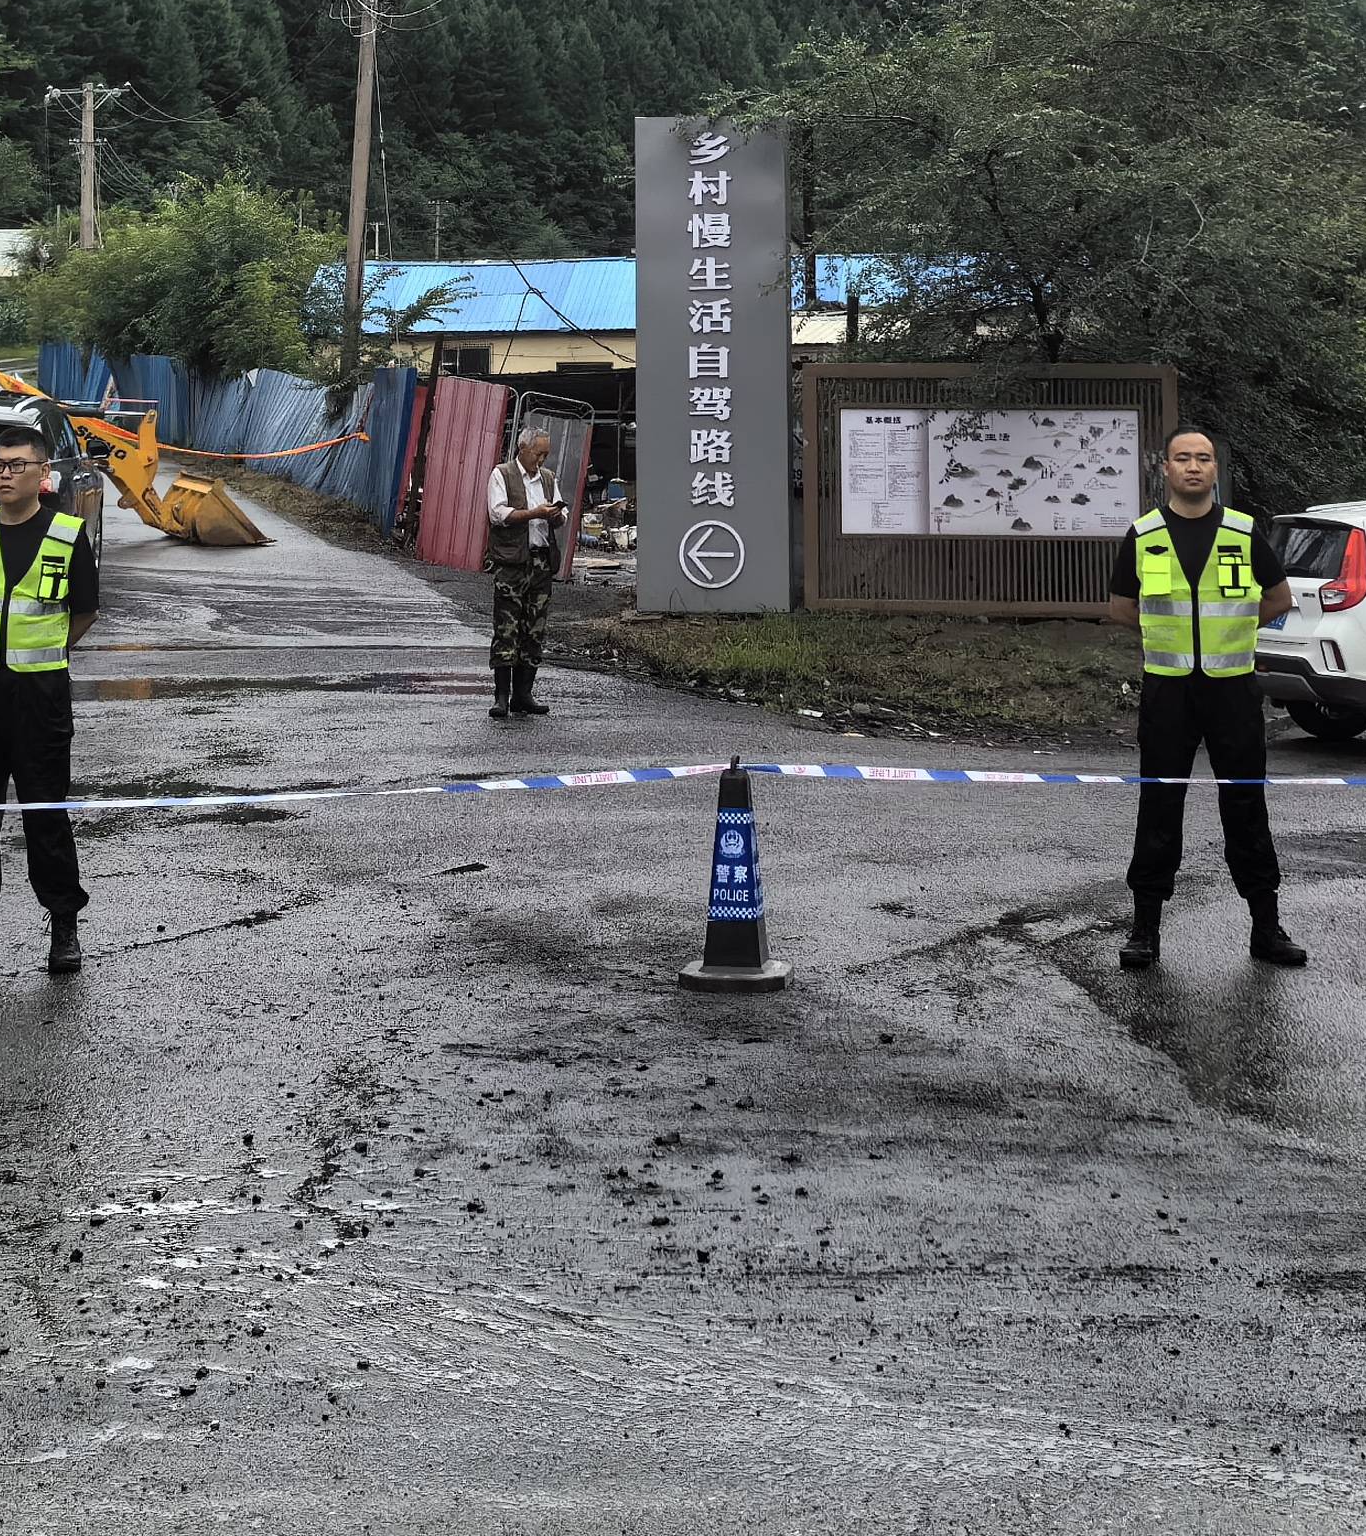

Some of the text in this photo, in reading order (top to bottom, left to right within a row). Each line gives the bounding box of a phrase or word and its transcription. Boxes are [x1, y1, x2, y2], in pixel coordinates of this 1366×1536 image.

[687, 132, 736, 507] 乡村慢生活自驾路线
[716, 864, 748, 884] 警察
[713, 888, 749, 902] POLICE
